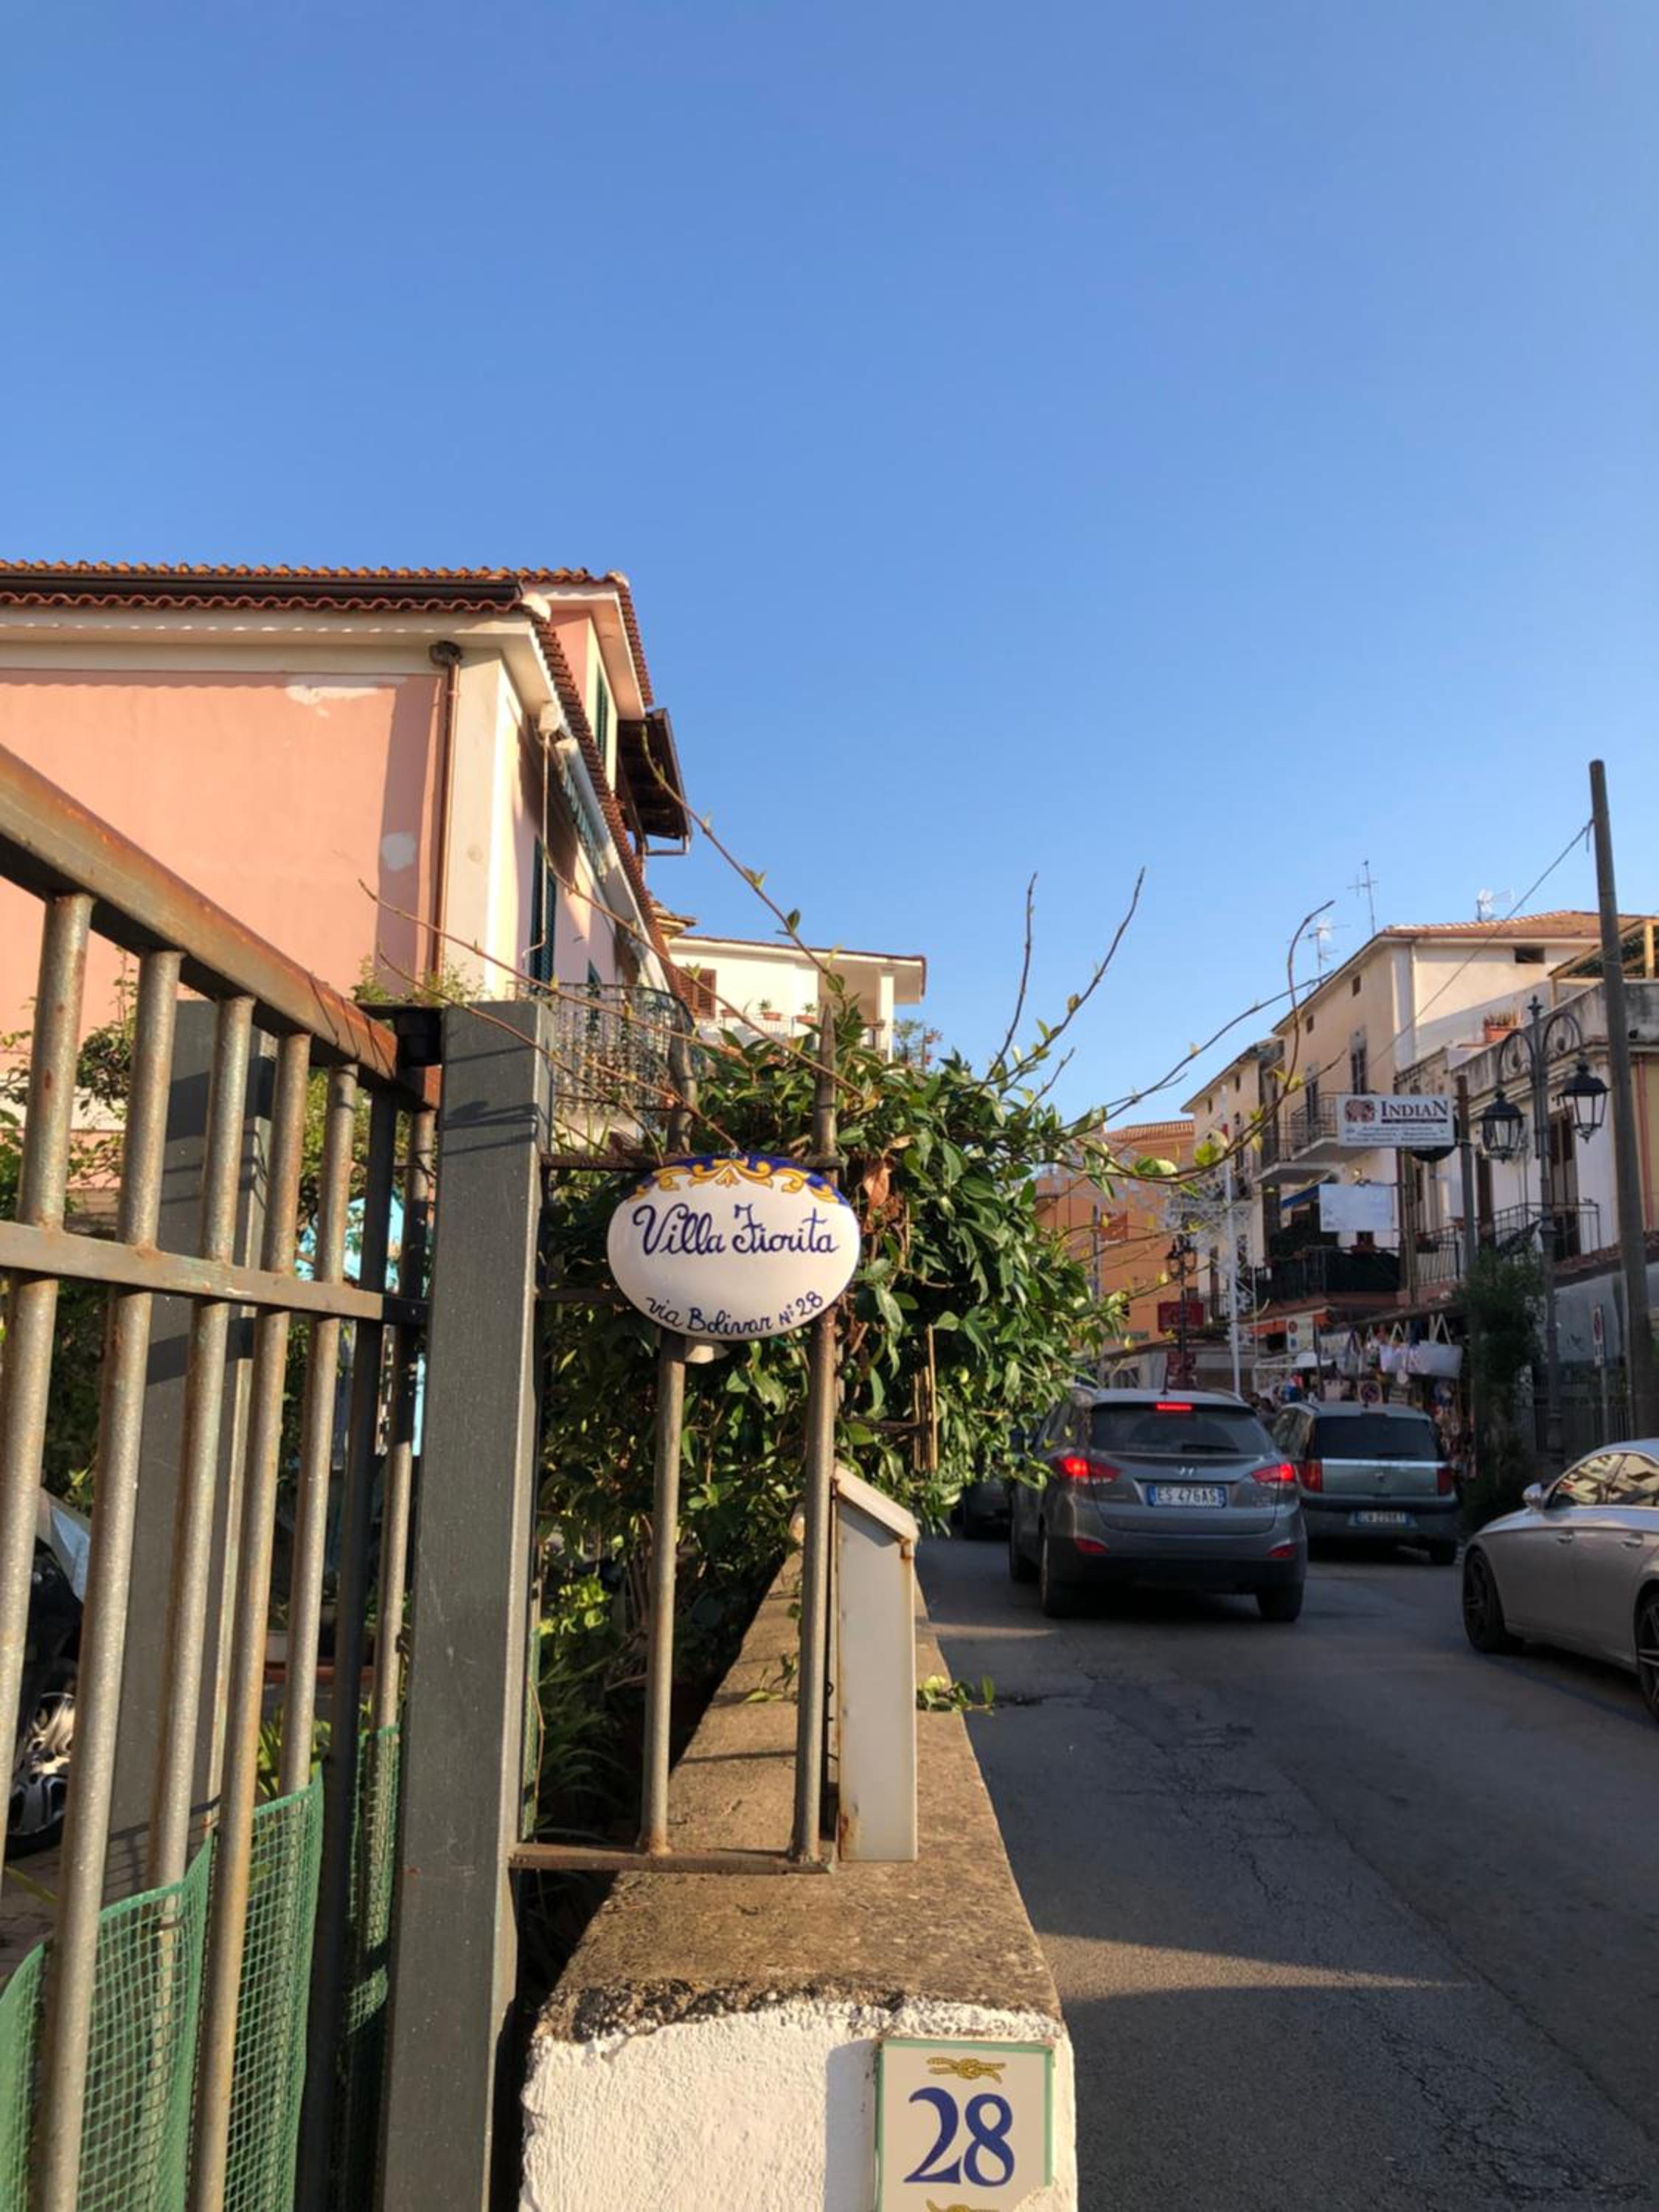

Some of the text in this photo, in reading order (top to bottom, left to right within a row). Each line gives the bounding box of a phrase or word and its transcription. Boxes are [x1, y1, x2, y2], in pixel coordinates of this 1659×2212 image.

[1380, 1099, 1448, 1117] INDIAN
[633, 1203, 840, 1256] Villa Fiorita
[686, 1307, 773, 1336] Bolivar
[796, 1290, 824, 1316] 28
[903, 2086, 1015, 2188] 28
